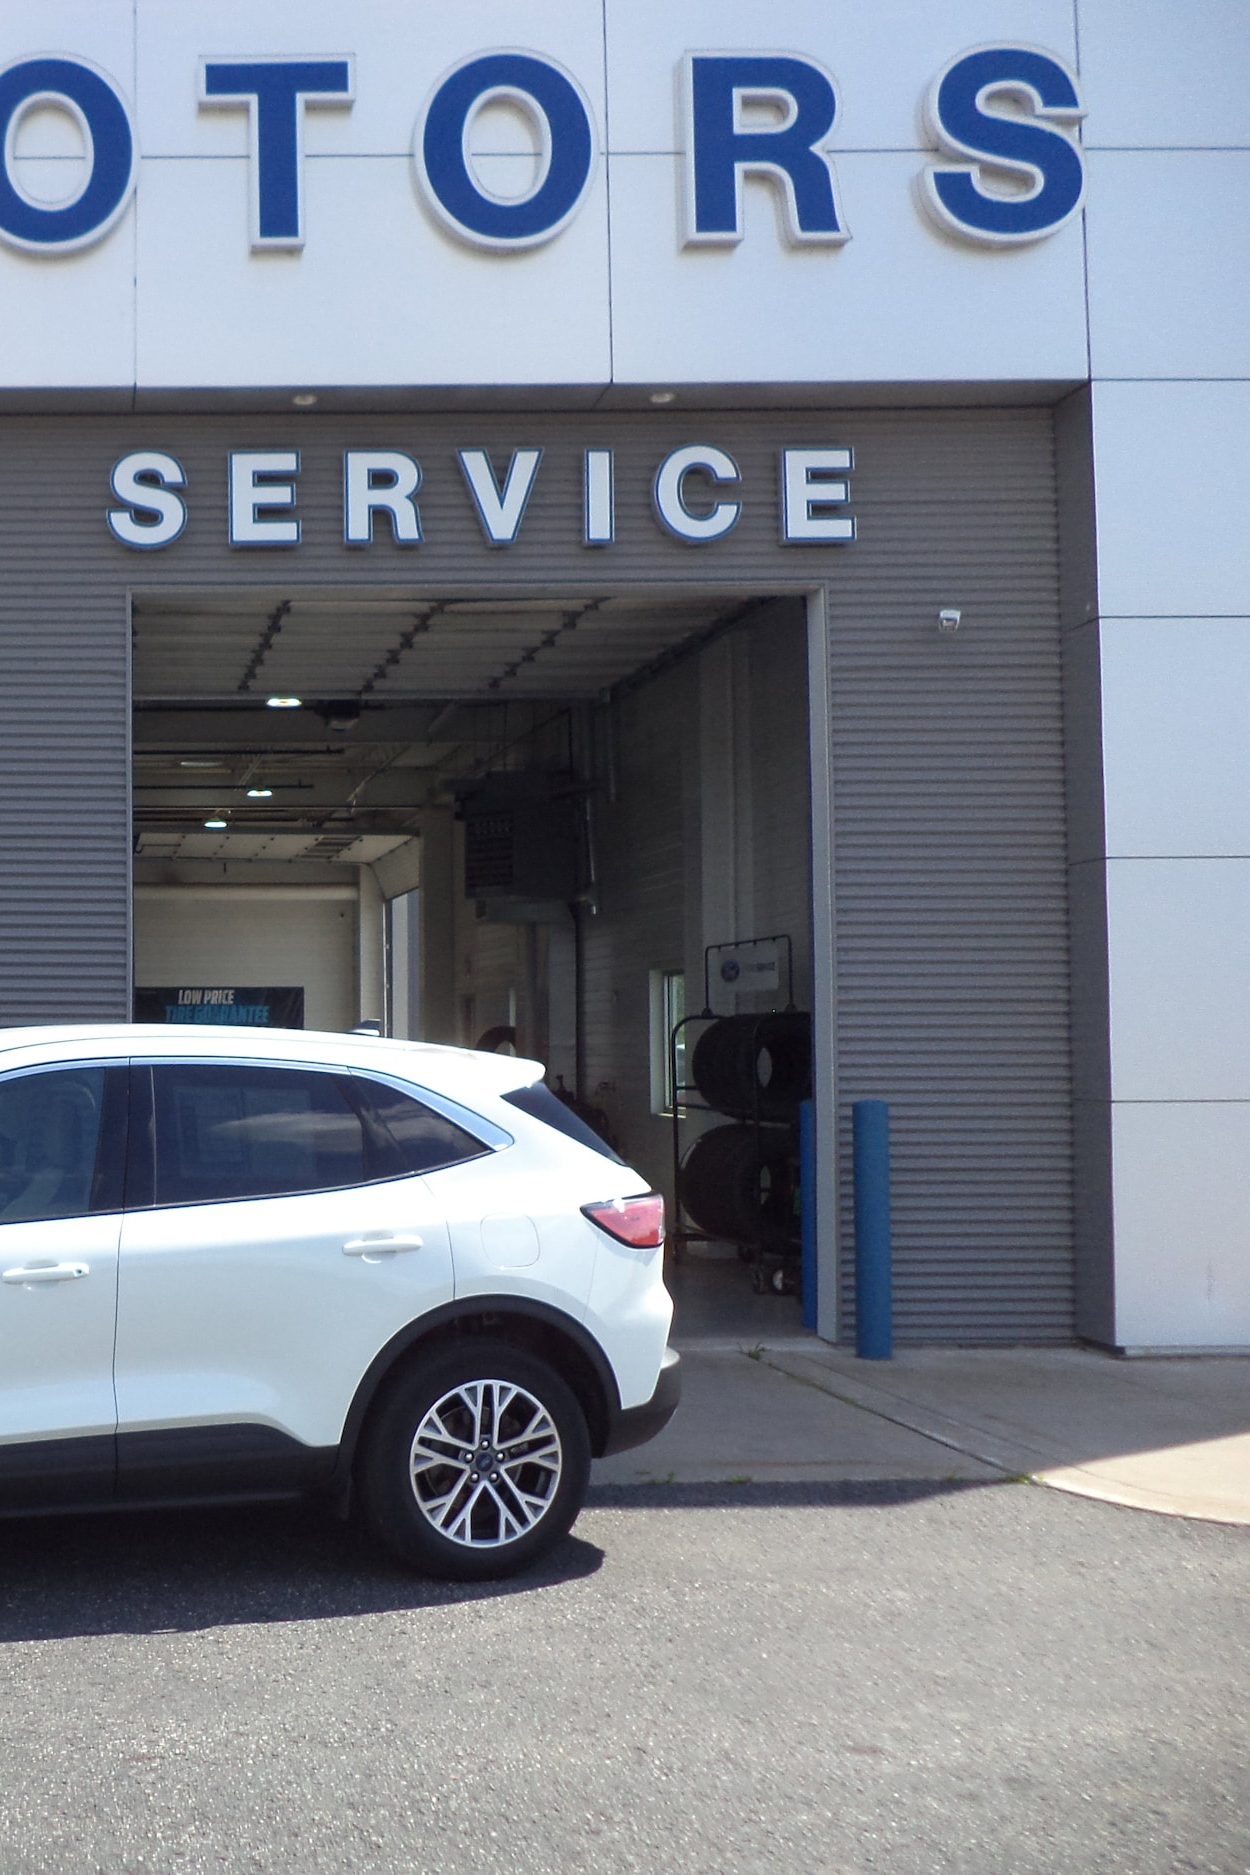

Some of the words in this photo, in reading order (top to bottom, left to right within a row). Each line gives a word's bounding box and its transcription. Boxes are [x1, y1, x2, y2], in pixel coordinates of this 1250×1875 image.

[106, 444, 856, 547] SERVICE
[178, 990, 203, 1005] LOW
[204, 990, 235, 1005] PRICE
[165, 1005, 193, 1023] TIRE
[194, 1005, 270, 1023] GUARANTEE
